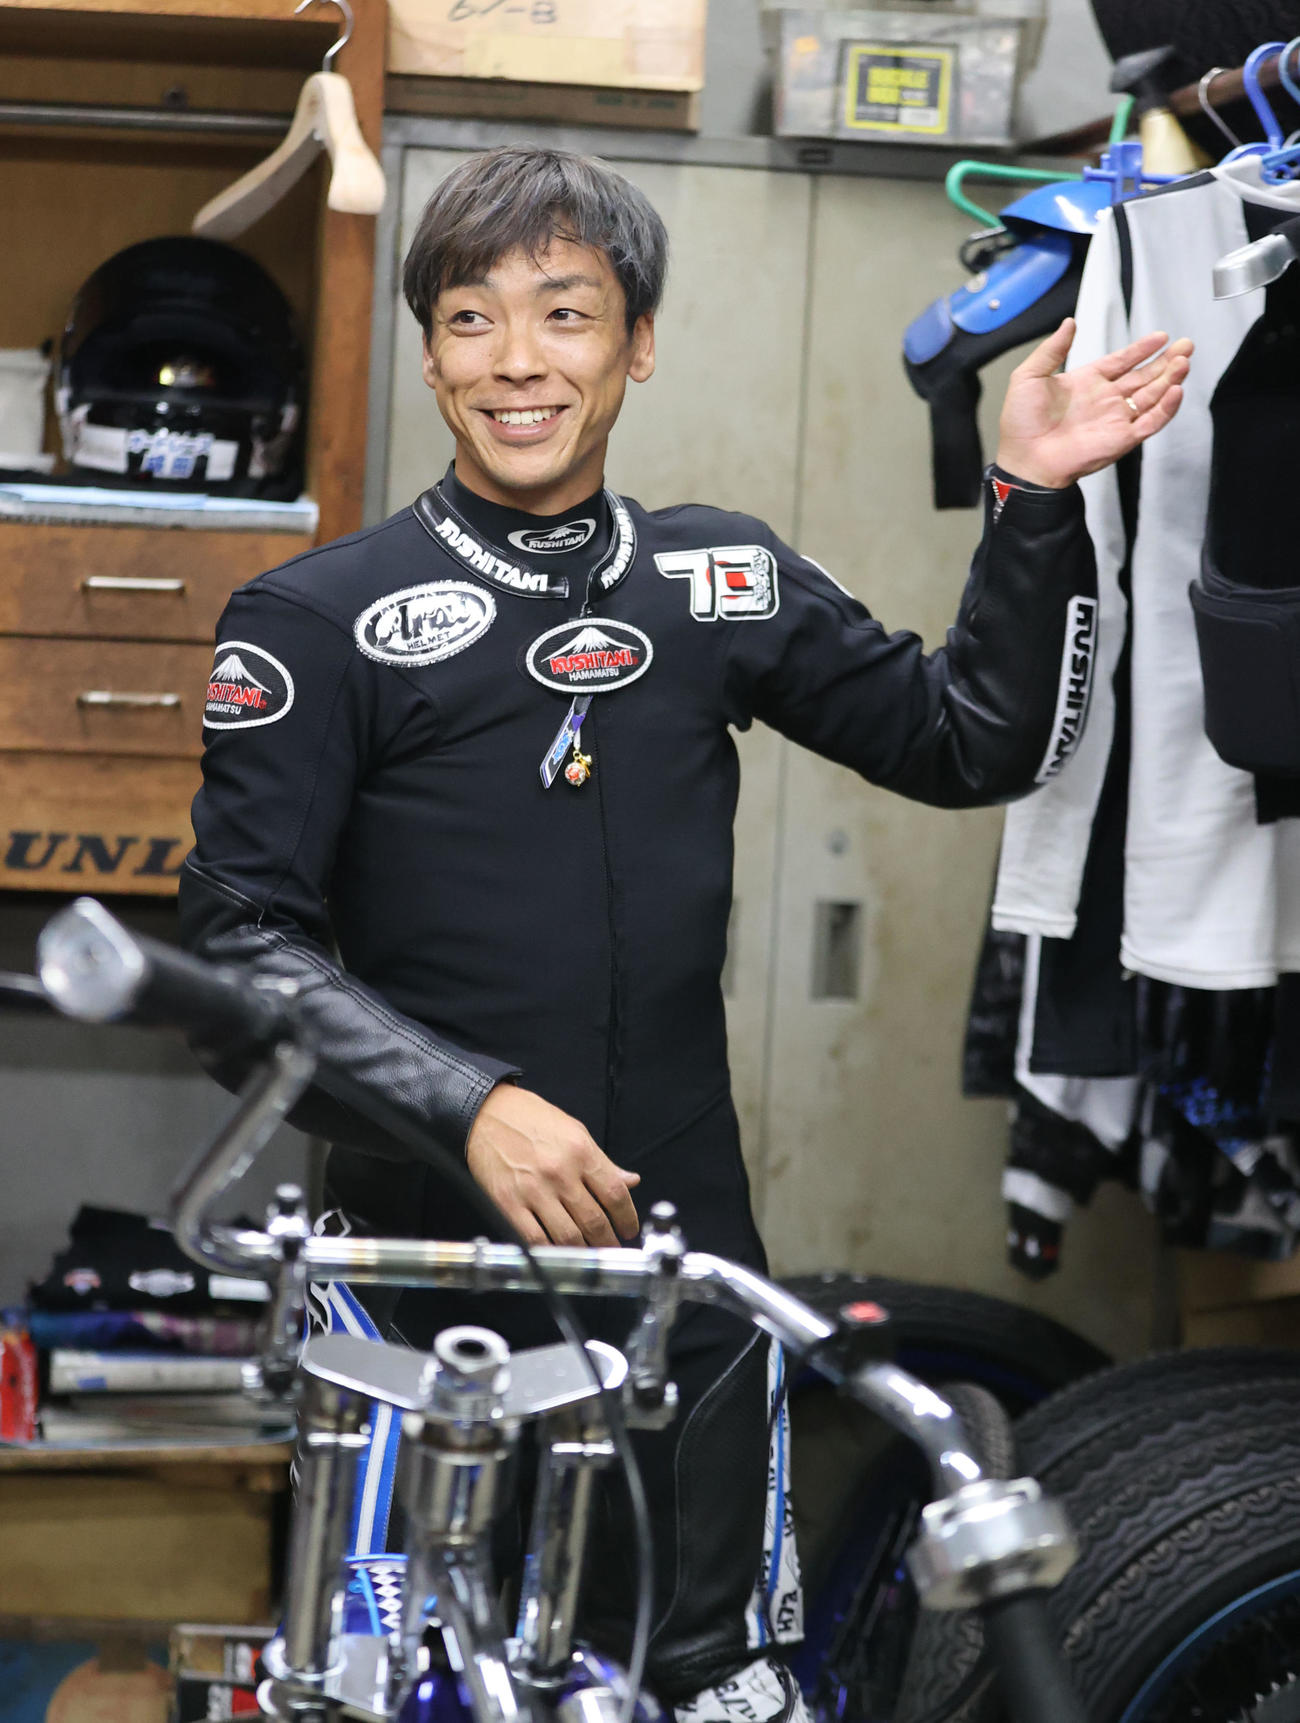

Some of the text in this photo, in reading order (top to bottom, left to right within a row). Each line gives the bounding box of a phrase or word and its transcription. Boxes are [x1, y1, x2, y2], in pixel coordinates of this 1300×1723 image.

[528, 533, 586, 549] KUSHITANI
[435, 517, 549, 592] KUSHITANI
[407, 631, 450, 650] HELMET
[550, 649, 633, 674] KUSHITANI
[569, 668, 619, 682] HAMAMATSU
